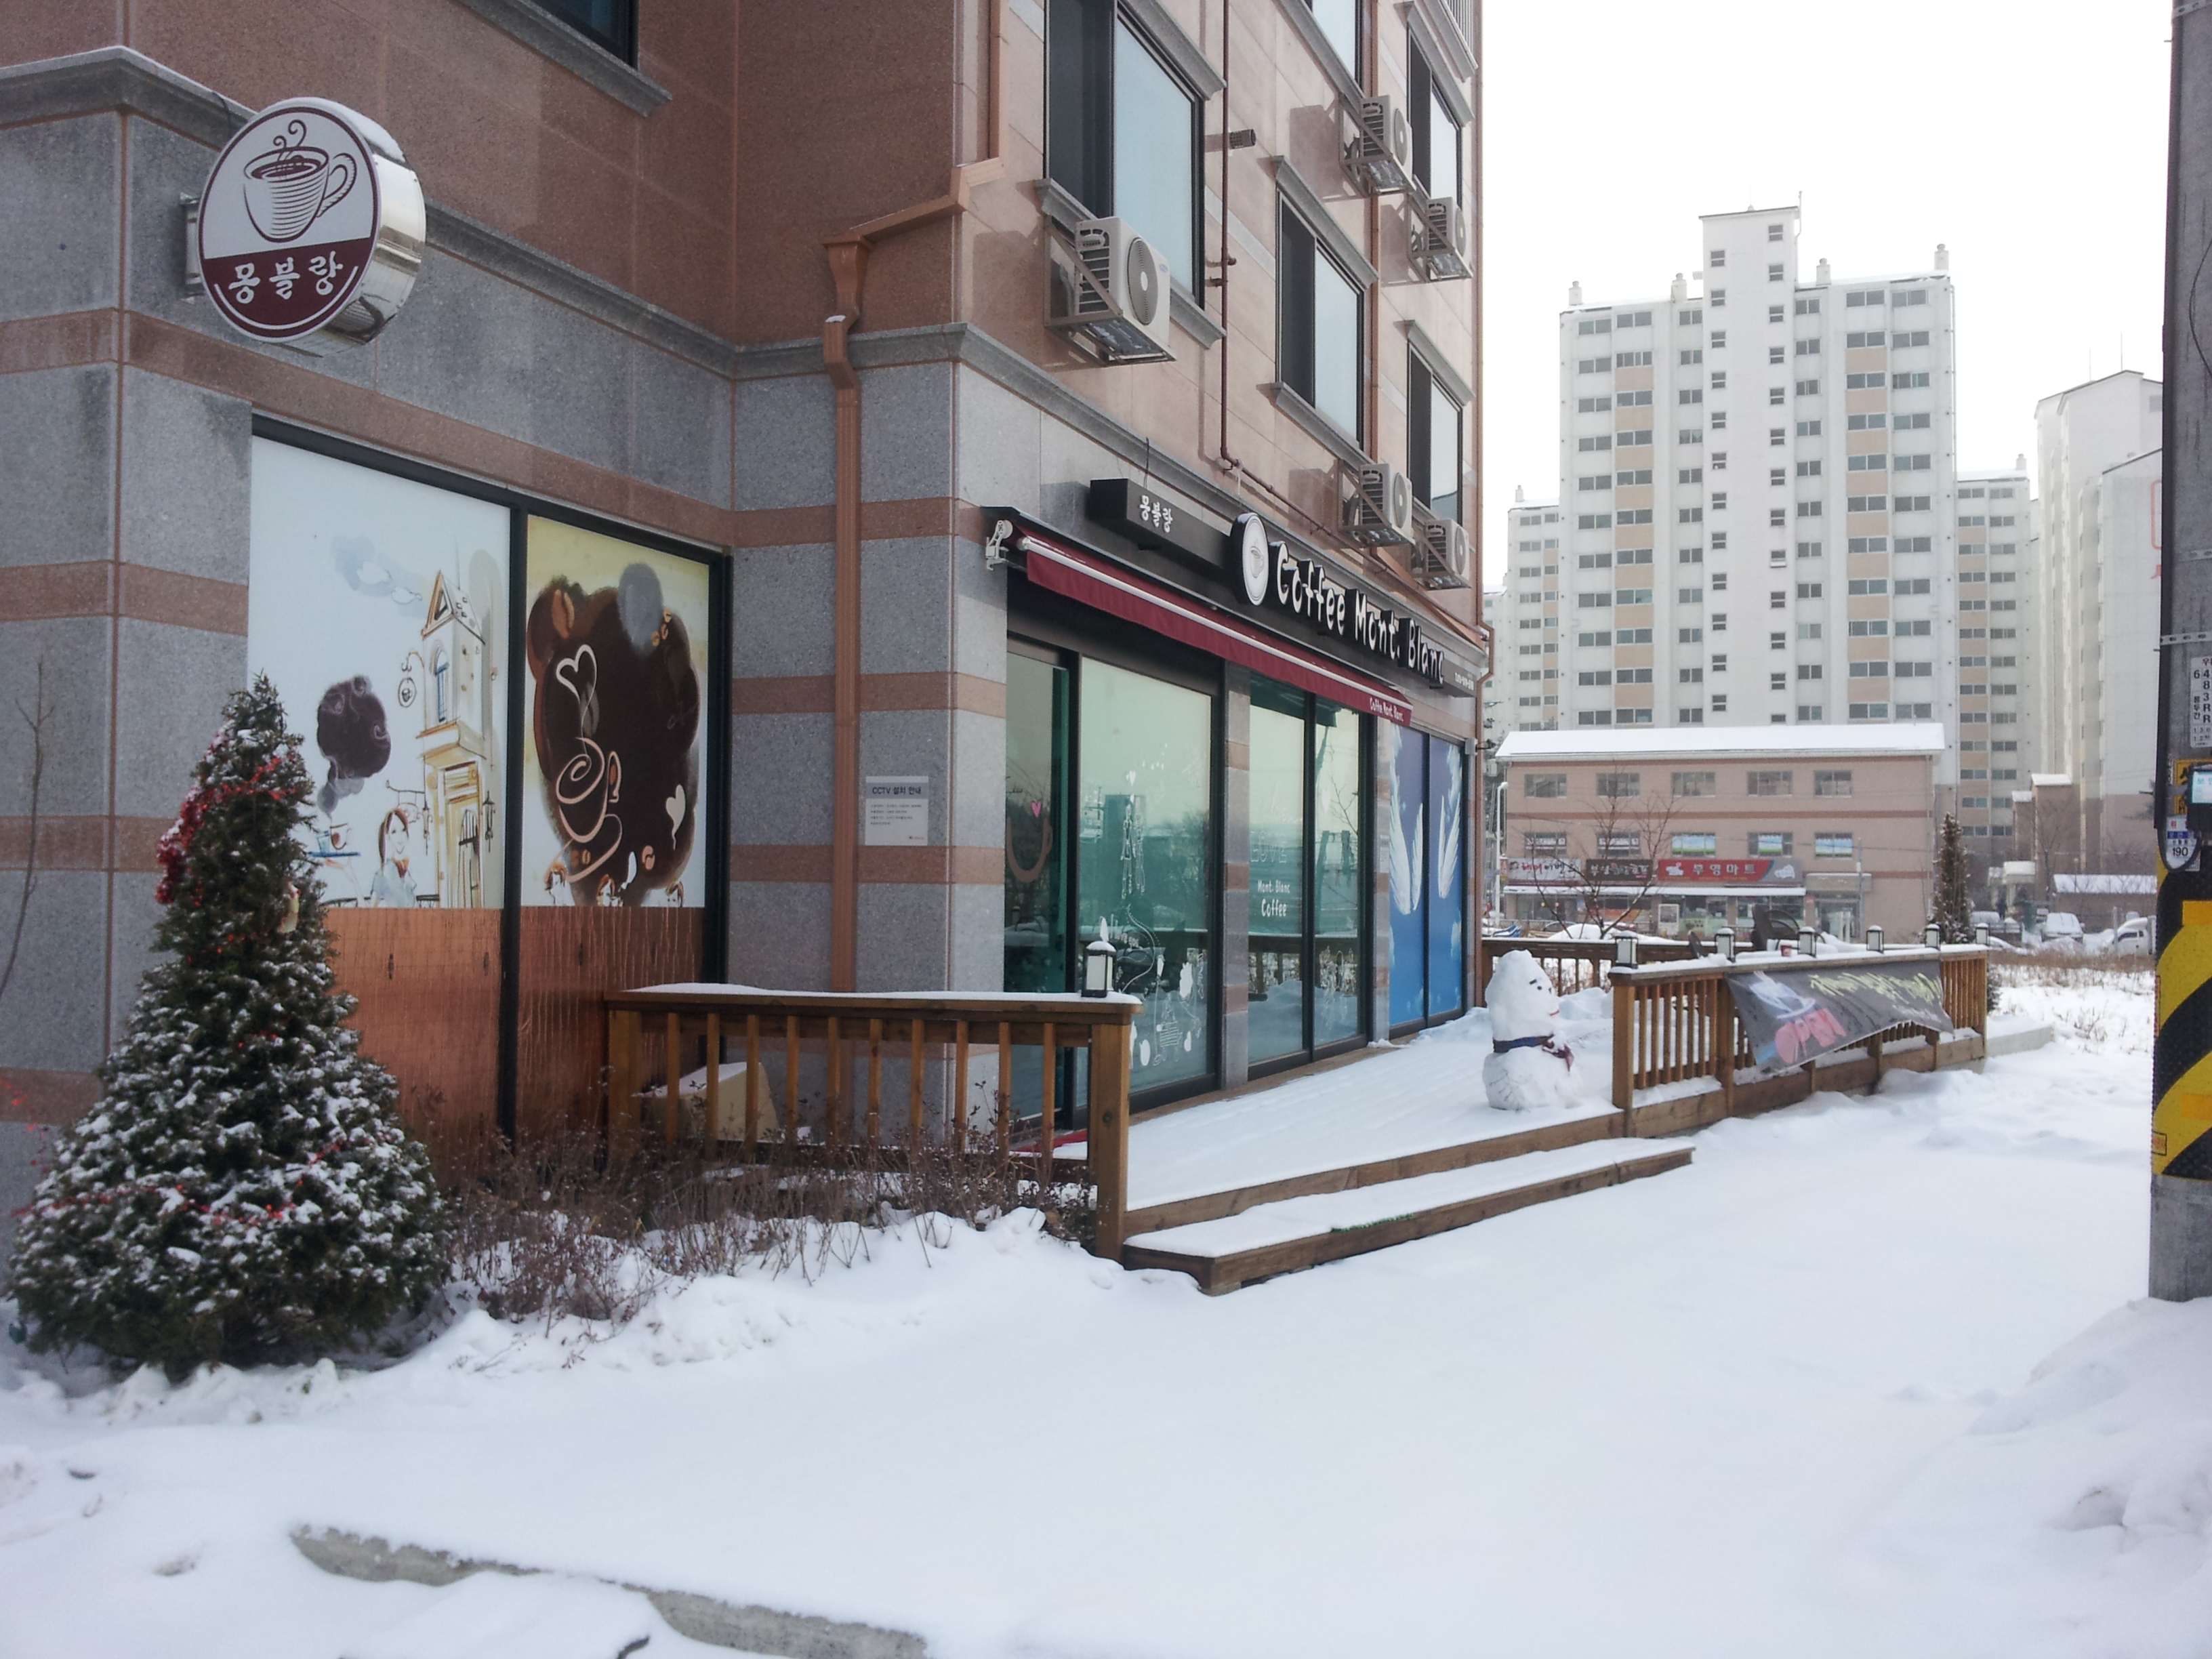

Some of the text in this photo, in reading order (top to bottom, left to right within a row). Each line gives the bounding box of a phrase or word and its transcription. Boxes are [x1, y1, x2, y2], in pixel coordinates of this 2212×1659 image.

[228, 250, 346, 305] 몽블랑
[1139, 495, 1173, 533] 몽블랑
[1277, 542, 1445, 684] Coffee Mont. Blanc
[2173, 846, 2188, 857] 190
[1275, 880, 1290, 894] Blanc
[1261, 898, 1287, 918] Coffee
